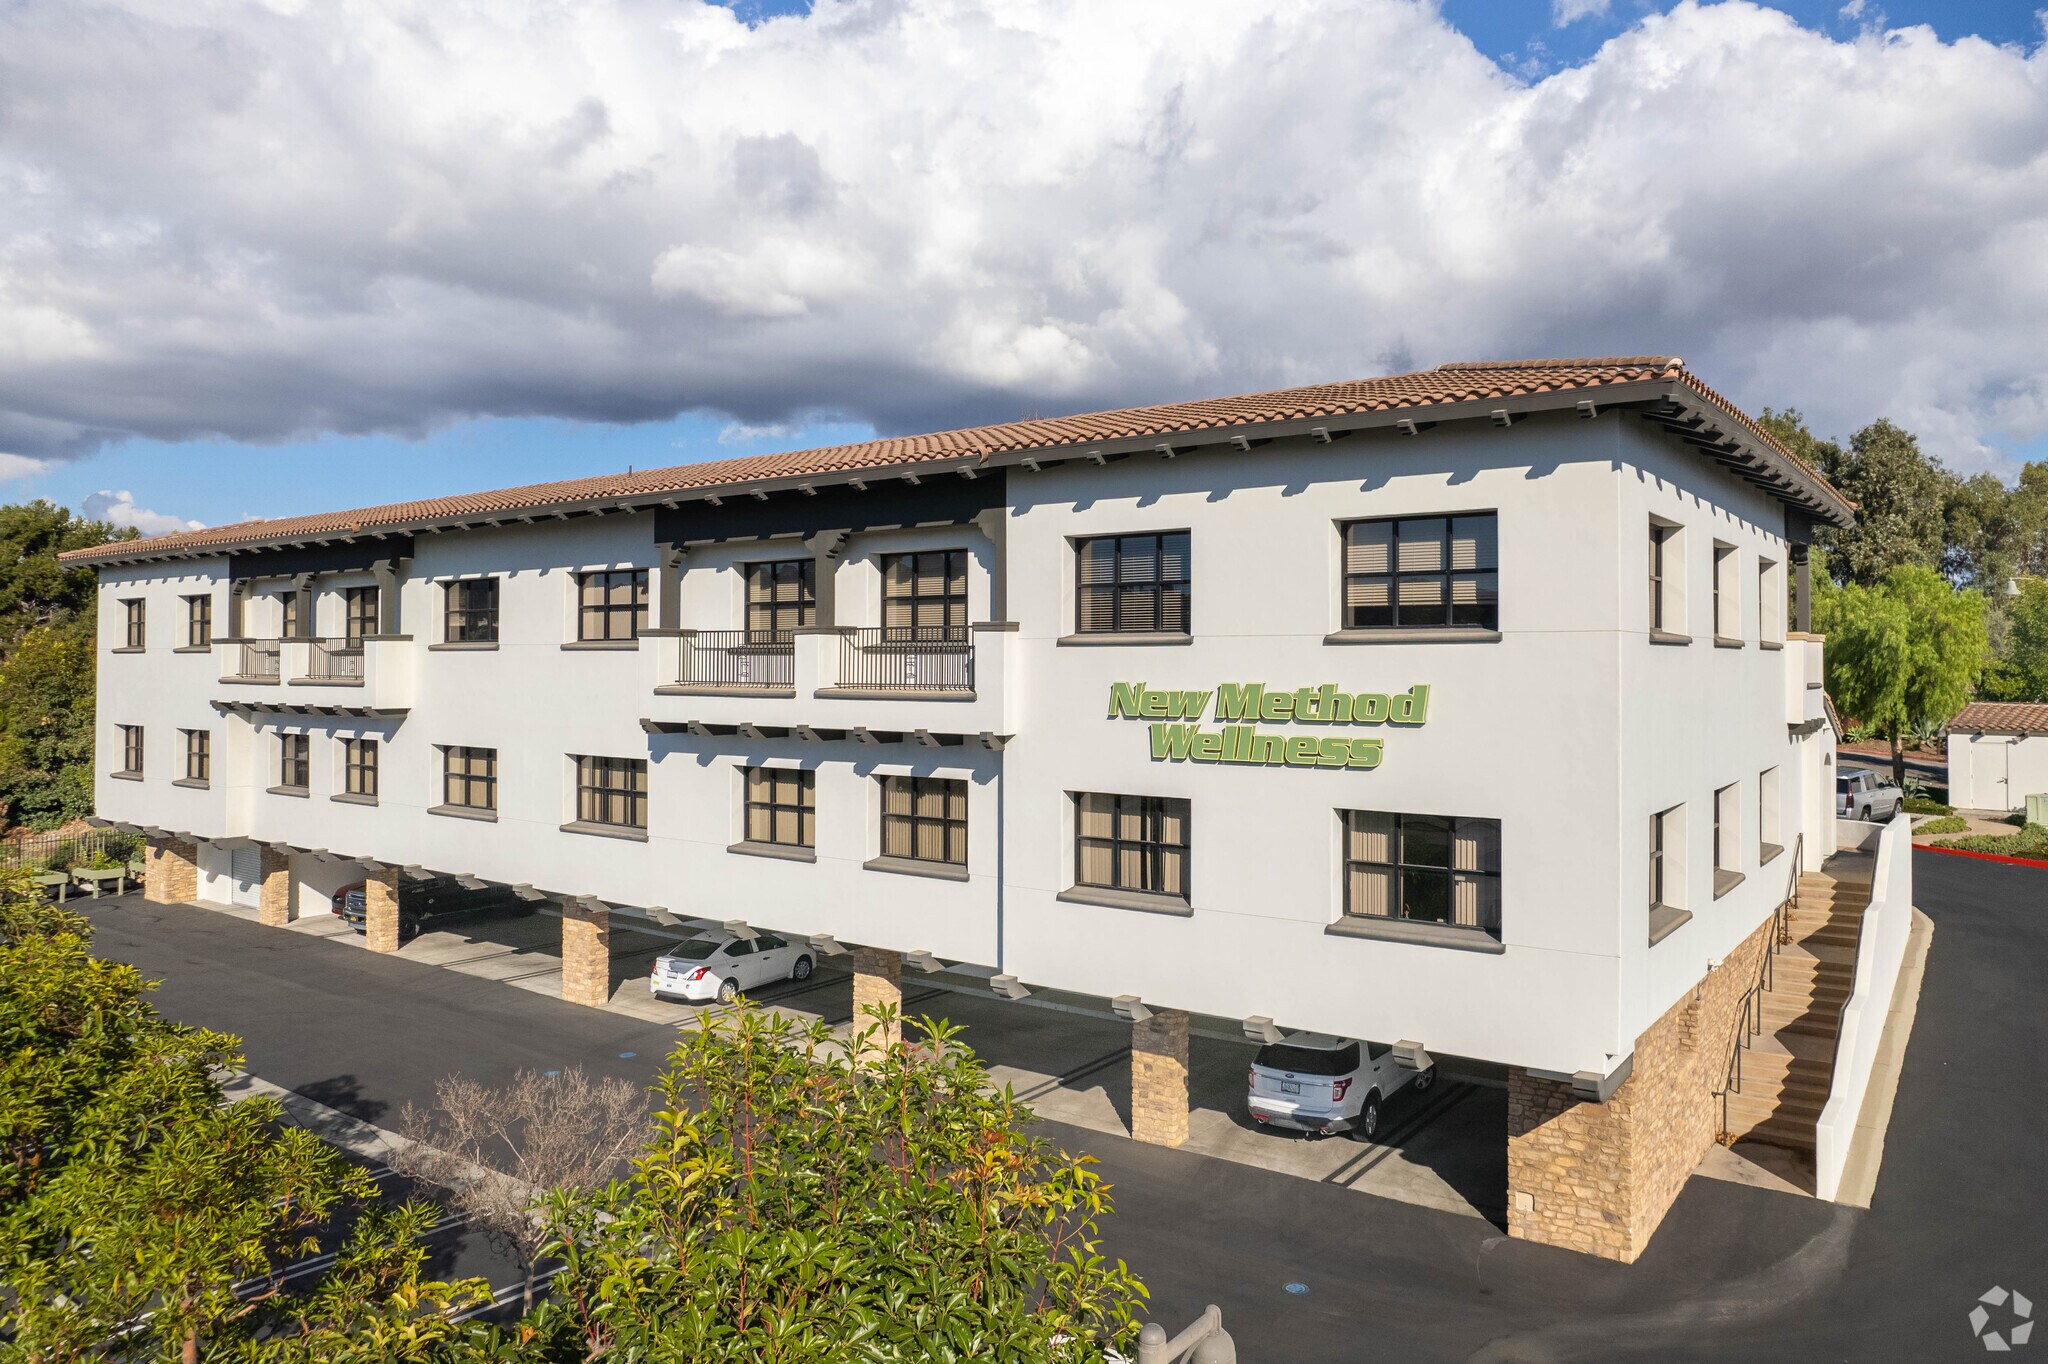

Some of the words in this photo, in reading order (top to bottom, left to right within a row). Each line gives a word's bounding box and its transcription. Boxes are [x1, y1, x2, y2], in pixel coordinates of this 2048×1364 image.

[1108, 682, 1212, 719] New
[1215, 682, 1430, 725] Method
[1149, 723, 1384, 769] Wellness
